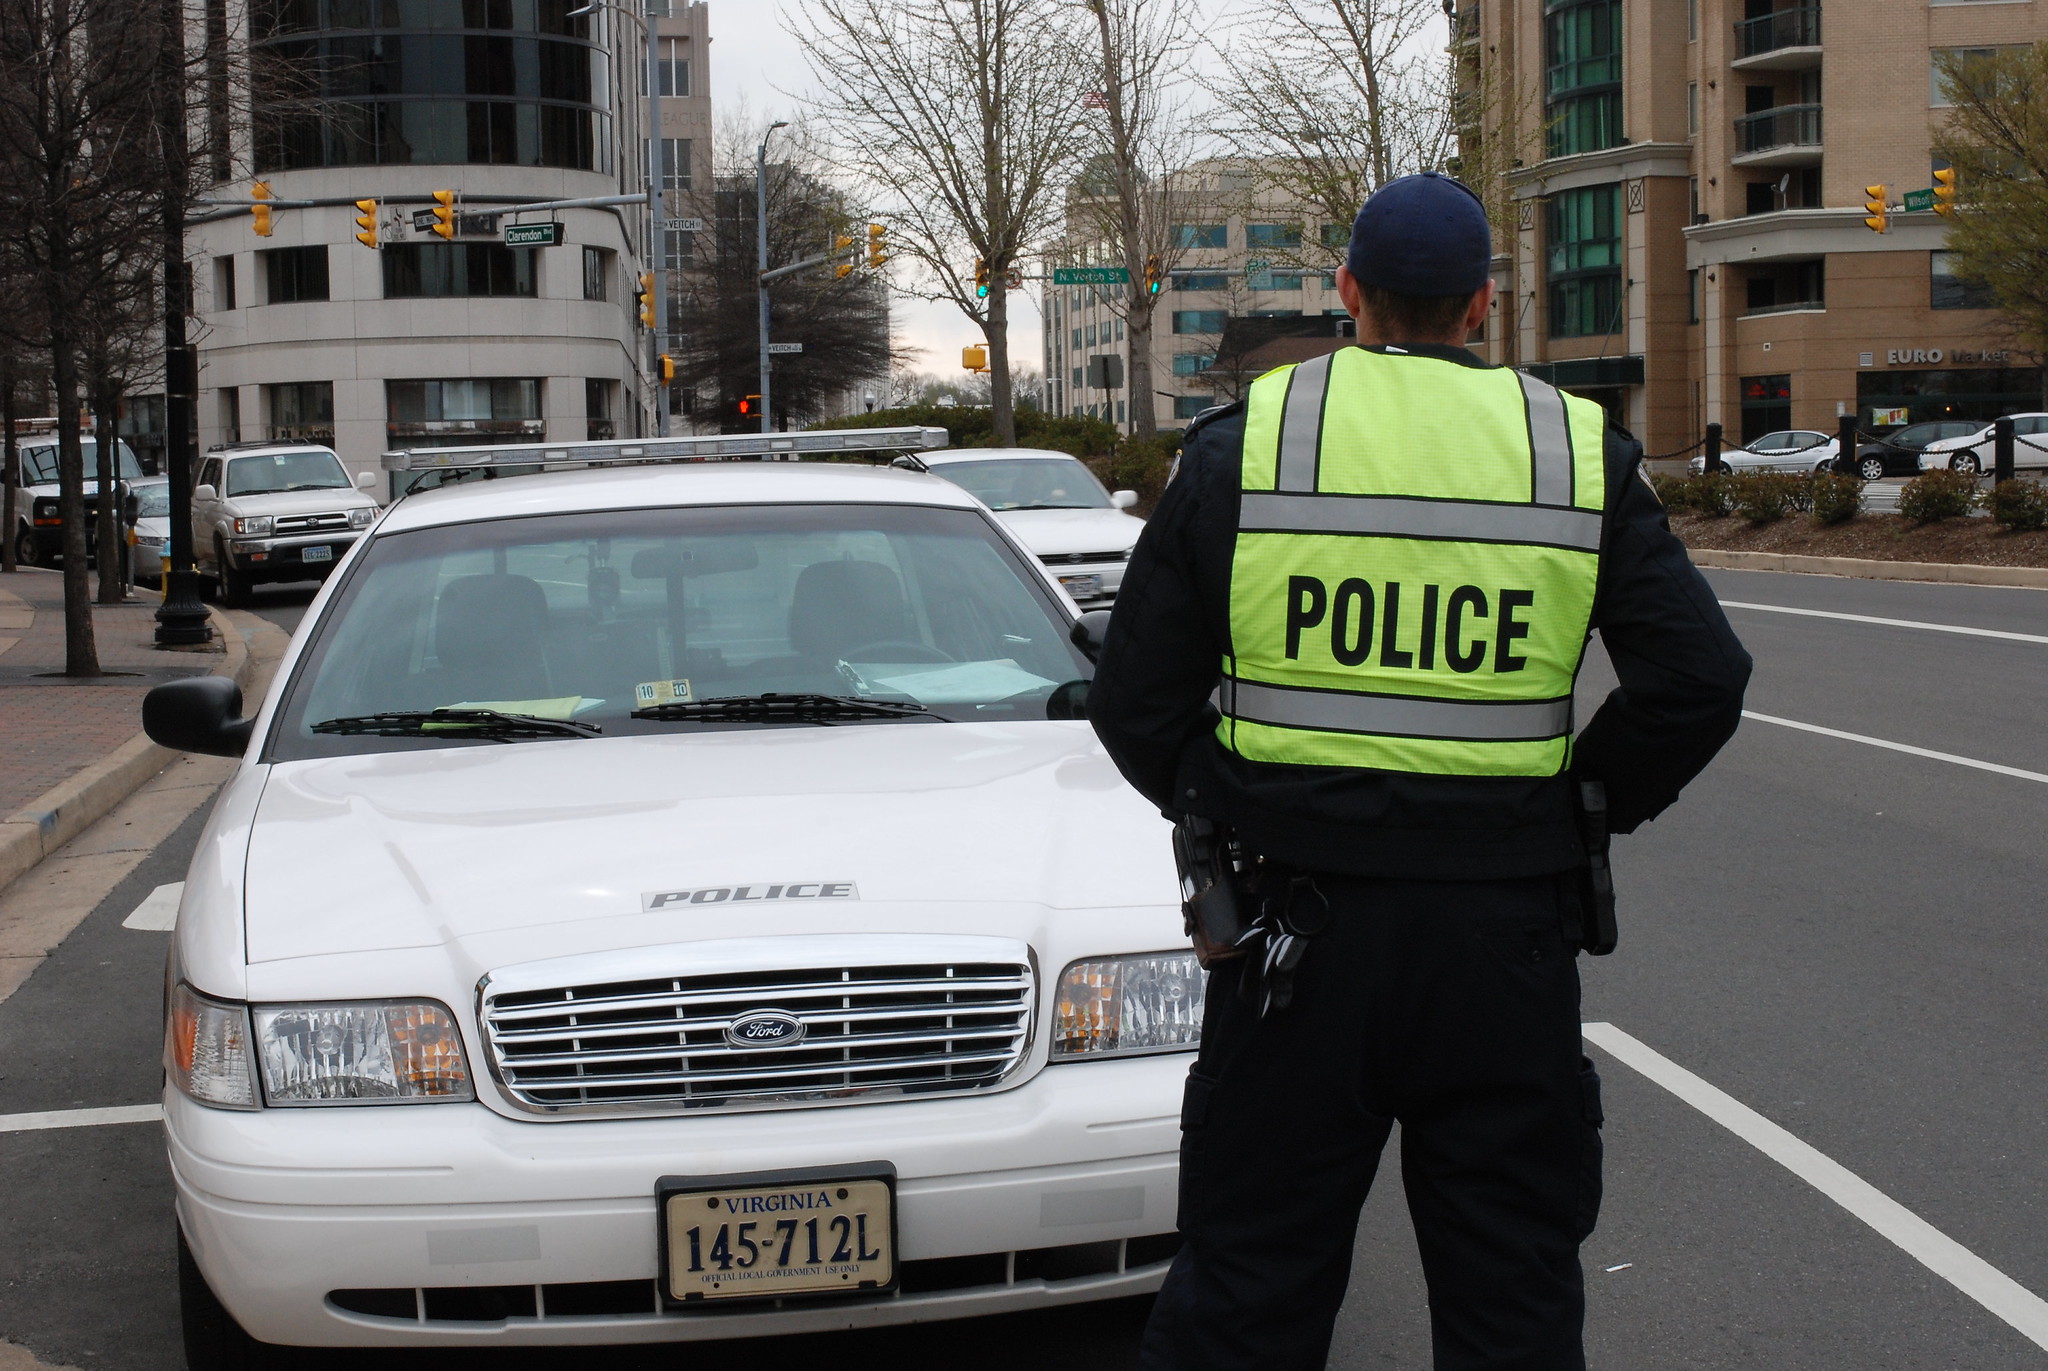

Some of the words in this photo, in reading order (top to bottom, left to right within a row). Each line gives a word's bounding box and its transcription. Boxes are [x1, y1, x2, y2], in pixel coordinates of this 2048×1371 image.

[669, 220, 695, 229] VEITCH
[508, 229, 542, 242] Clarendon
[1887, 349, 1944, 365] EURO
[1285, 575, 1534, 674] POLICE
[641, 685, 653, 698] 10
[674, 683, 687, 696] 10
[650, 883, 852, 908] POLICE
[746, 1021, 784, 1038] Ford
[725, 1191, 832, 1214] VIRGINIA
[686, 1213, 880, 1272] 145-712L
[701, 1272, 738, 1283] OFFICIAL
[739, 1269, 766, 1280] LOCAL
[766, 1266, 821, 1278] GOVERNMENT
[825, 1265, 840, 1274] USE
[840, 1264, 861, 1273] ONLY
